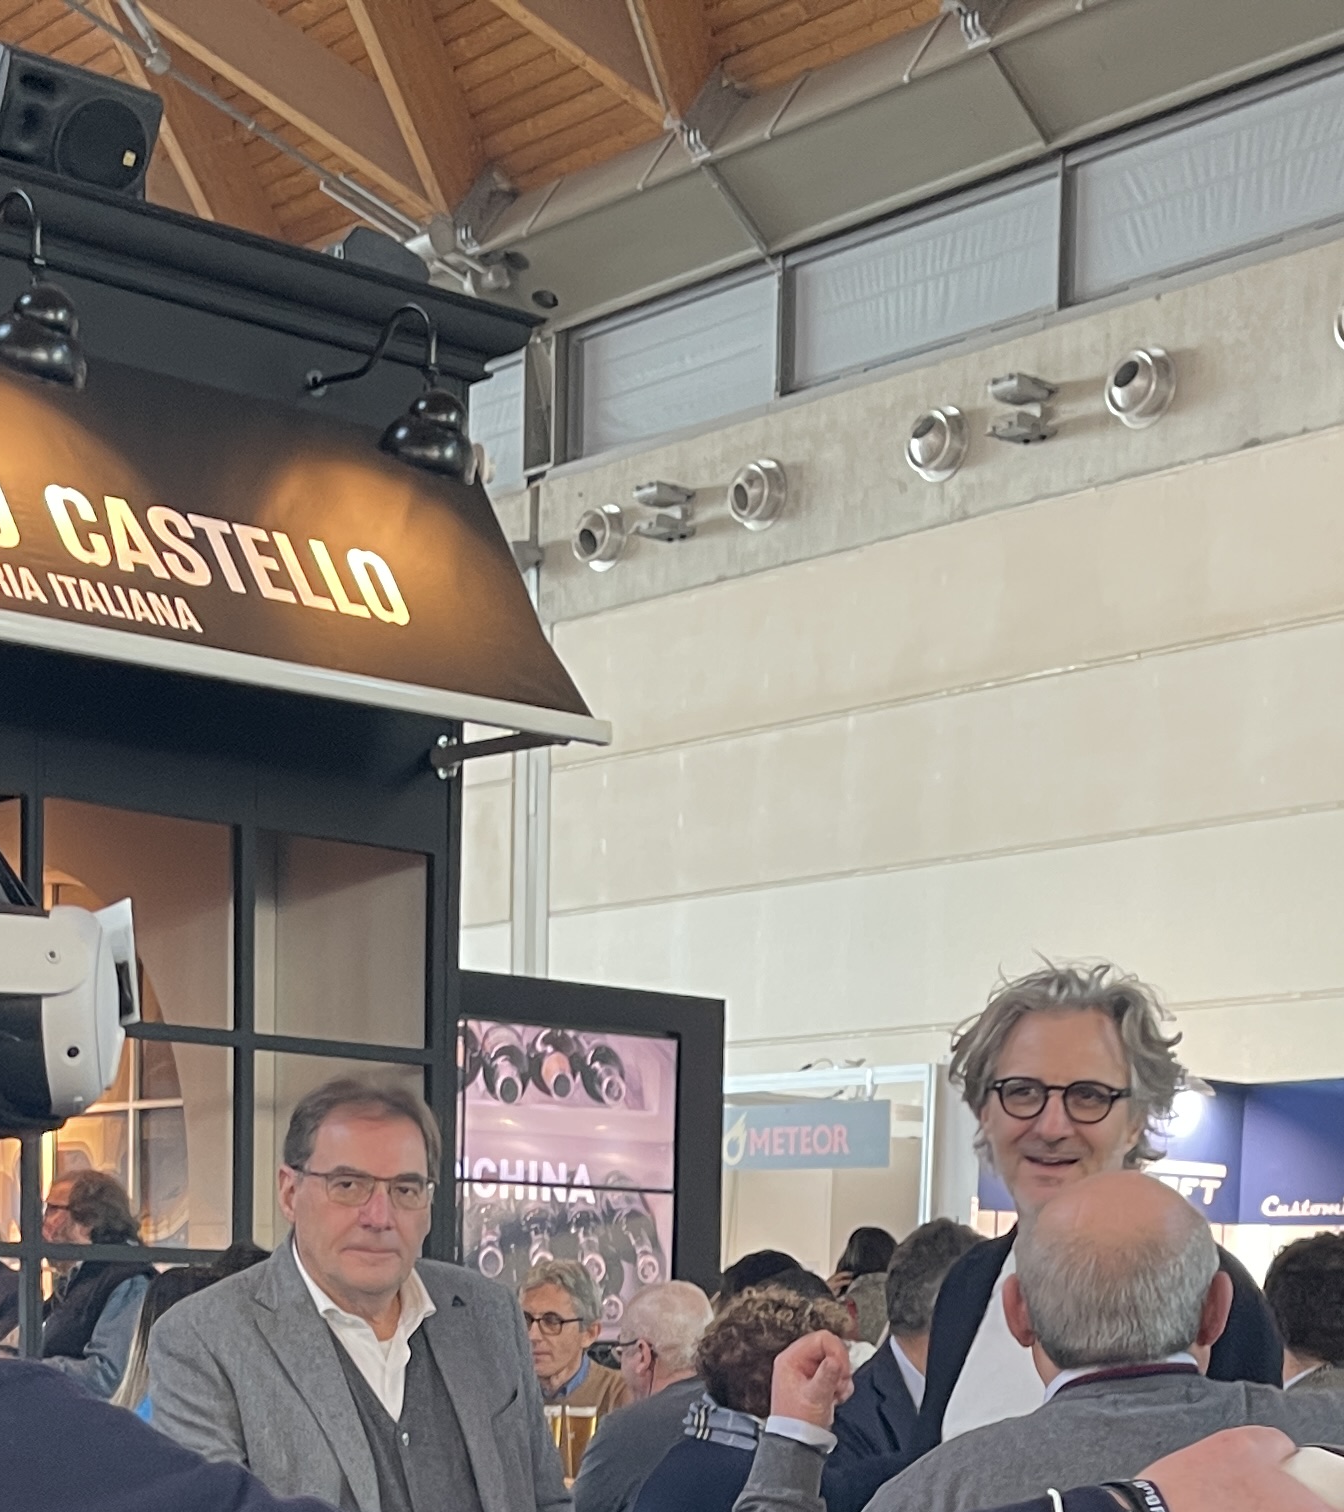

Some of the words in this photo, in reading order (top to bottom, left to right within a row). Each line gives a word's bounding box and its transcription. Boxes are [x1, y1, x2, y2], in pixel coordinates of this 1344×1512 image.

[44, 483, 411, 626] CASTELLO
[47, 571, 204, 633] ITALIANA
[749, 1123, 850, 1157] METEOR
